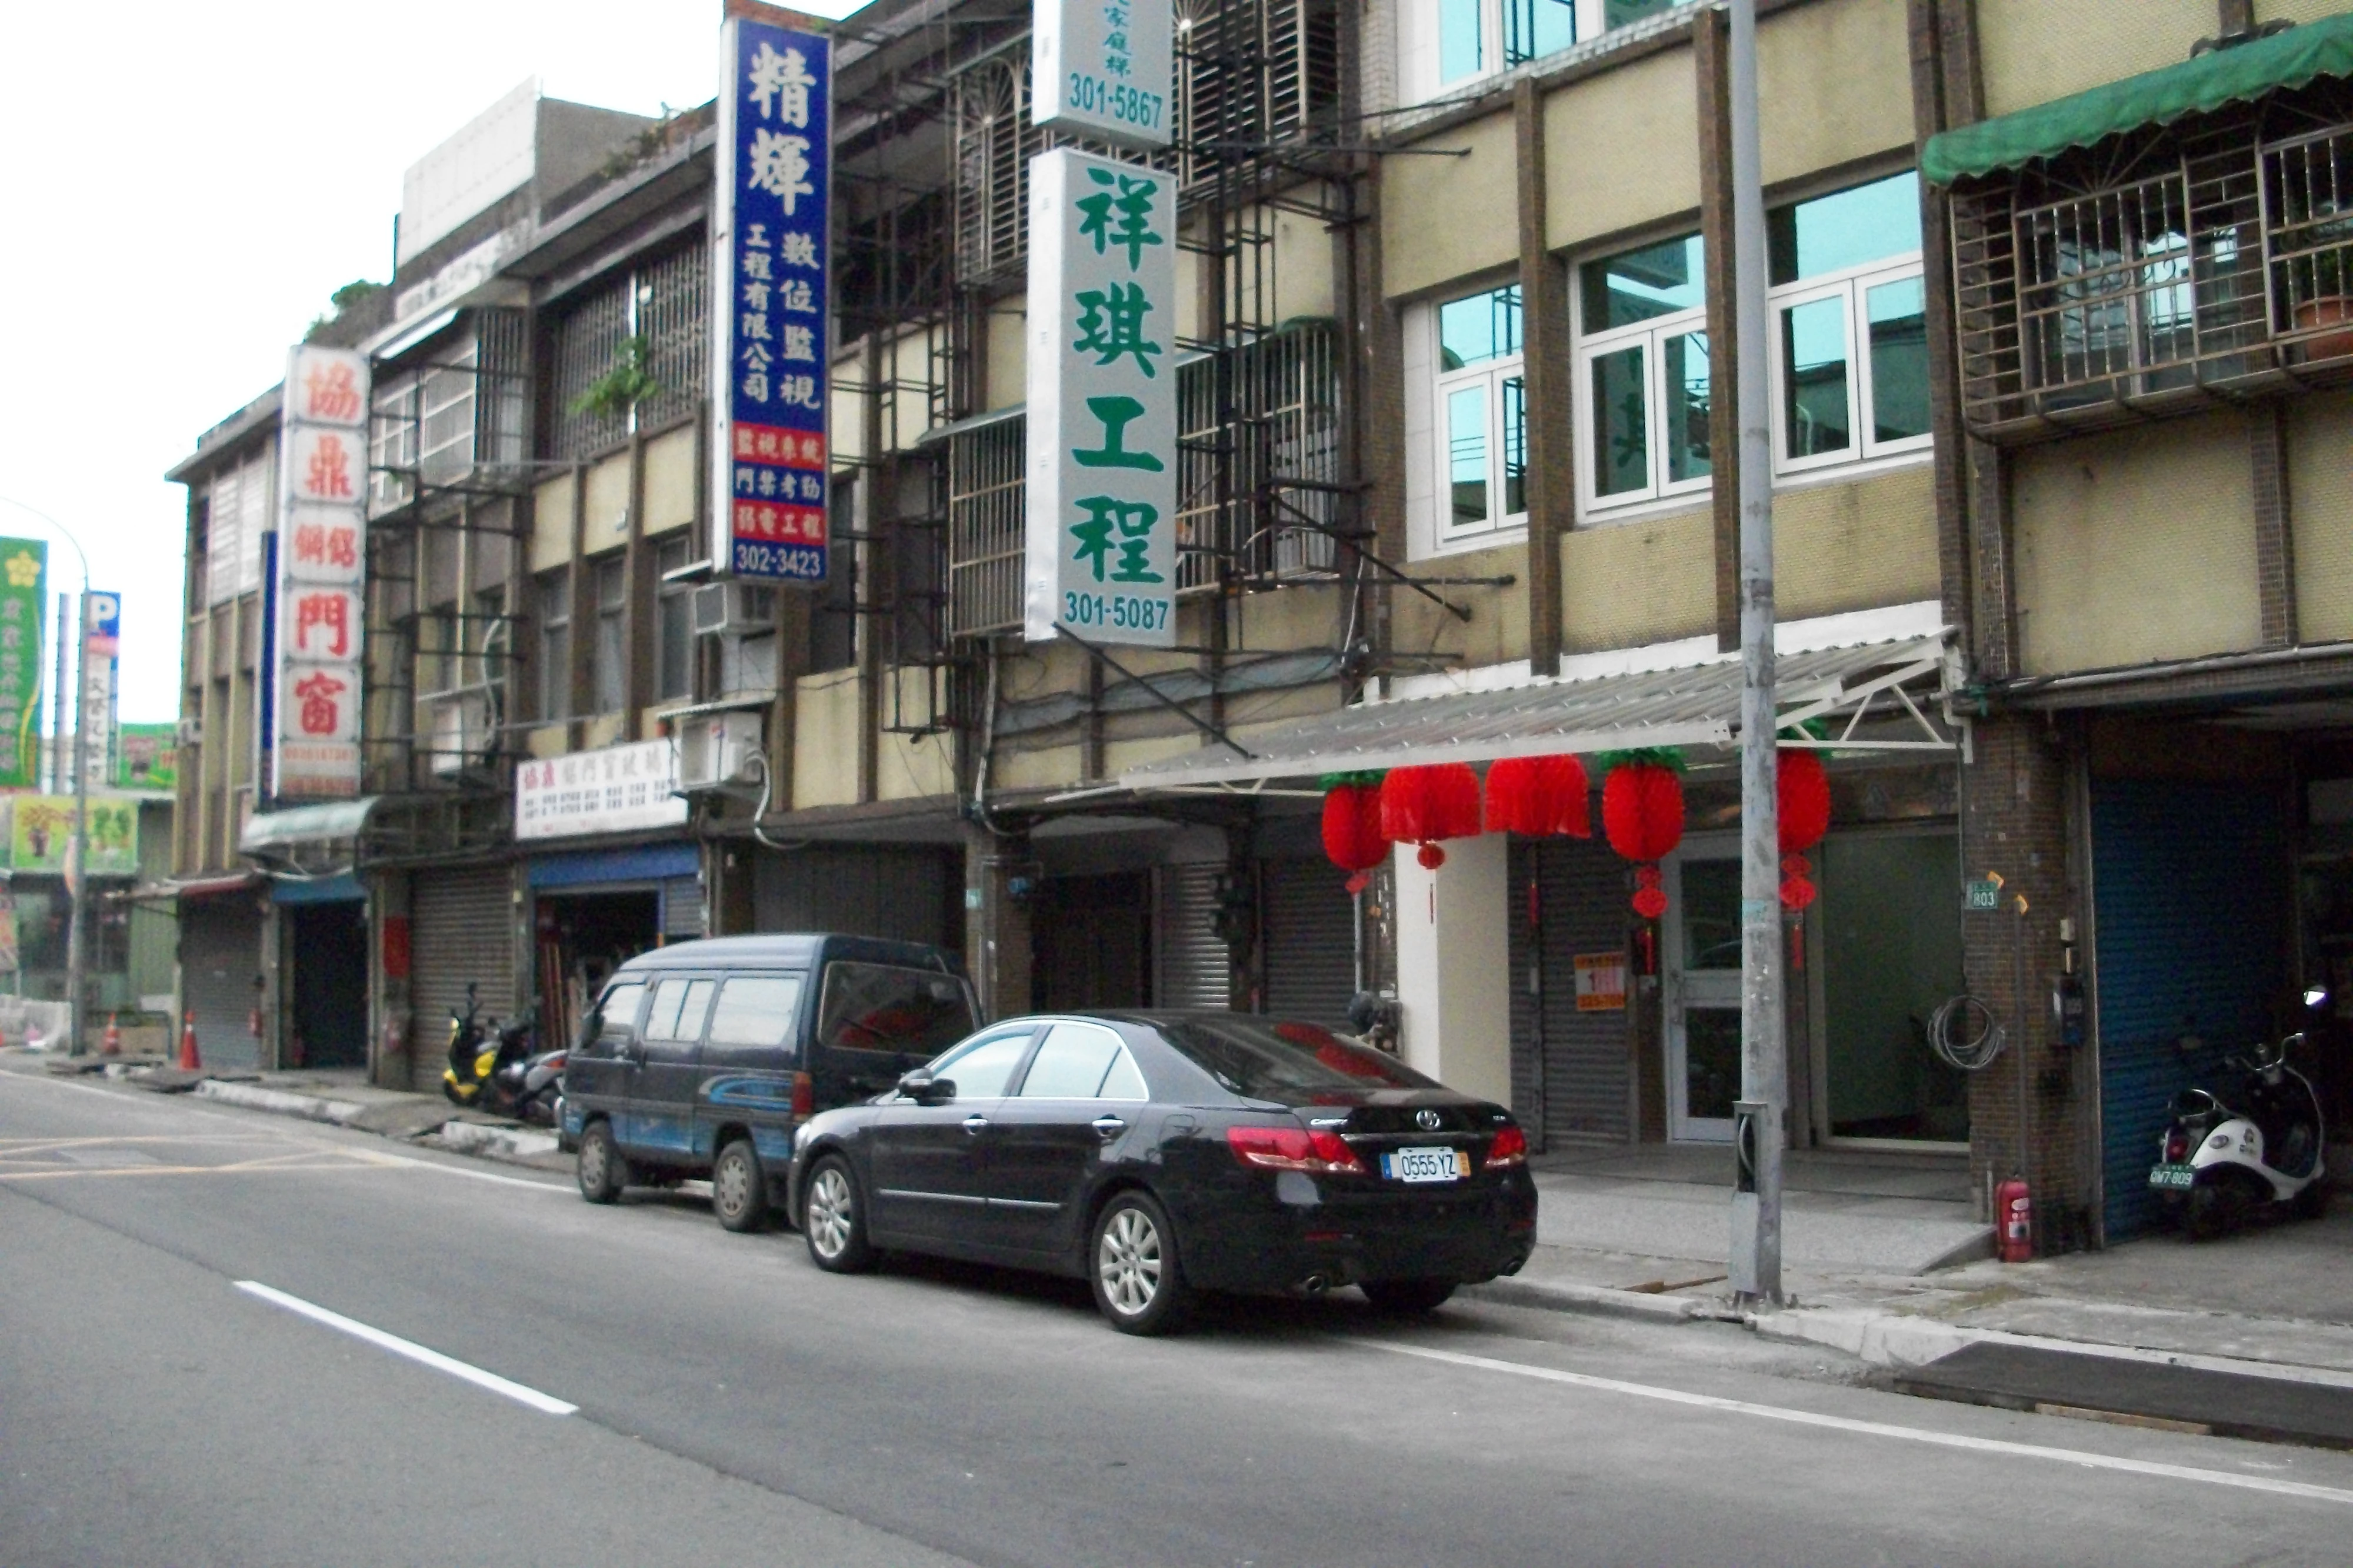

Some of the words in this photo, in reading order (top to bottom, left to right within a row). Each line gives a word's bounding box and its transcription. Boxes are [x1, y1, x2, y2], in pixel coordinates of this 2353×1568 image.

[1069, 73, 1163, 129] 301-5867
[748, 42, 817, 216] 精輝
[742, 223, 773, 403] 工程有限公司
[779, 231, 821, 410] 數位監視
[1069, 167, 1165, 583] 祥琪工程
[736, 468, 821, 500] 門禁考勤
[737, 505, 821, 538] 弱電工程
[736, 543, 821, 577] 302-3423
[90, 595, 117, 628] P
[1065, 590, 1169, 630] 301-5087
[1401, 1153, 1457, 1176] 0555-YZ
